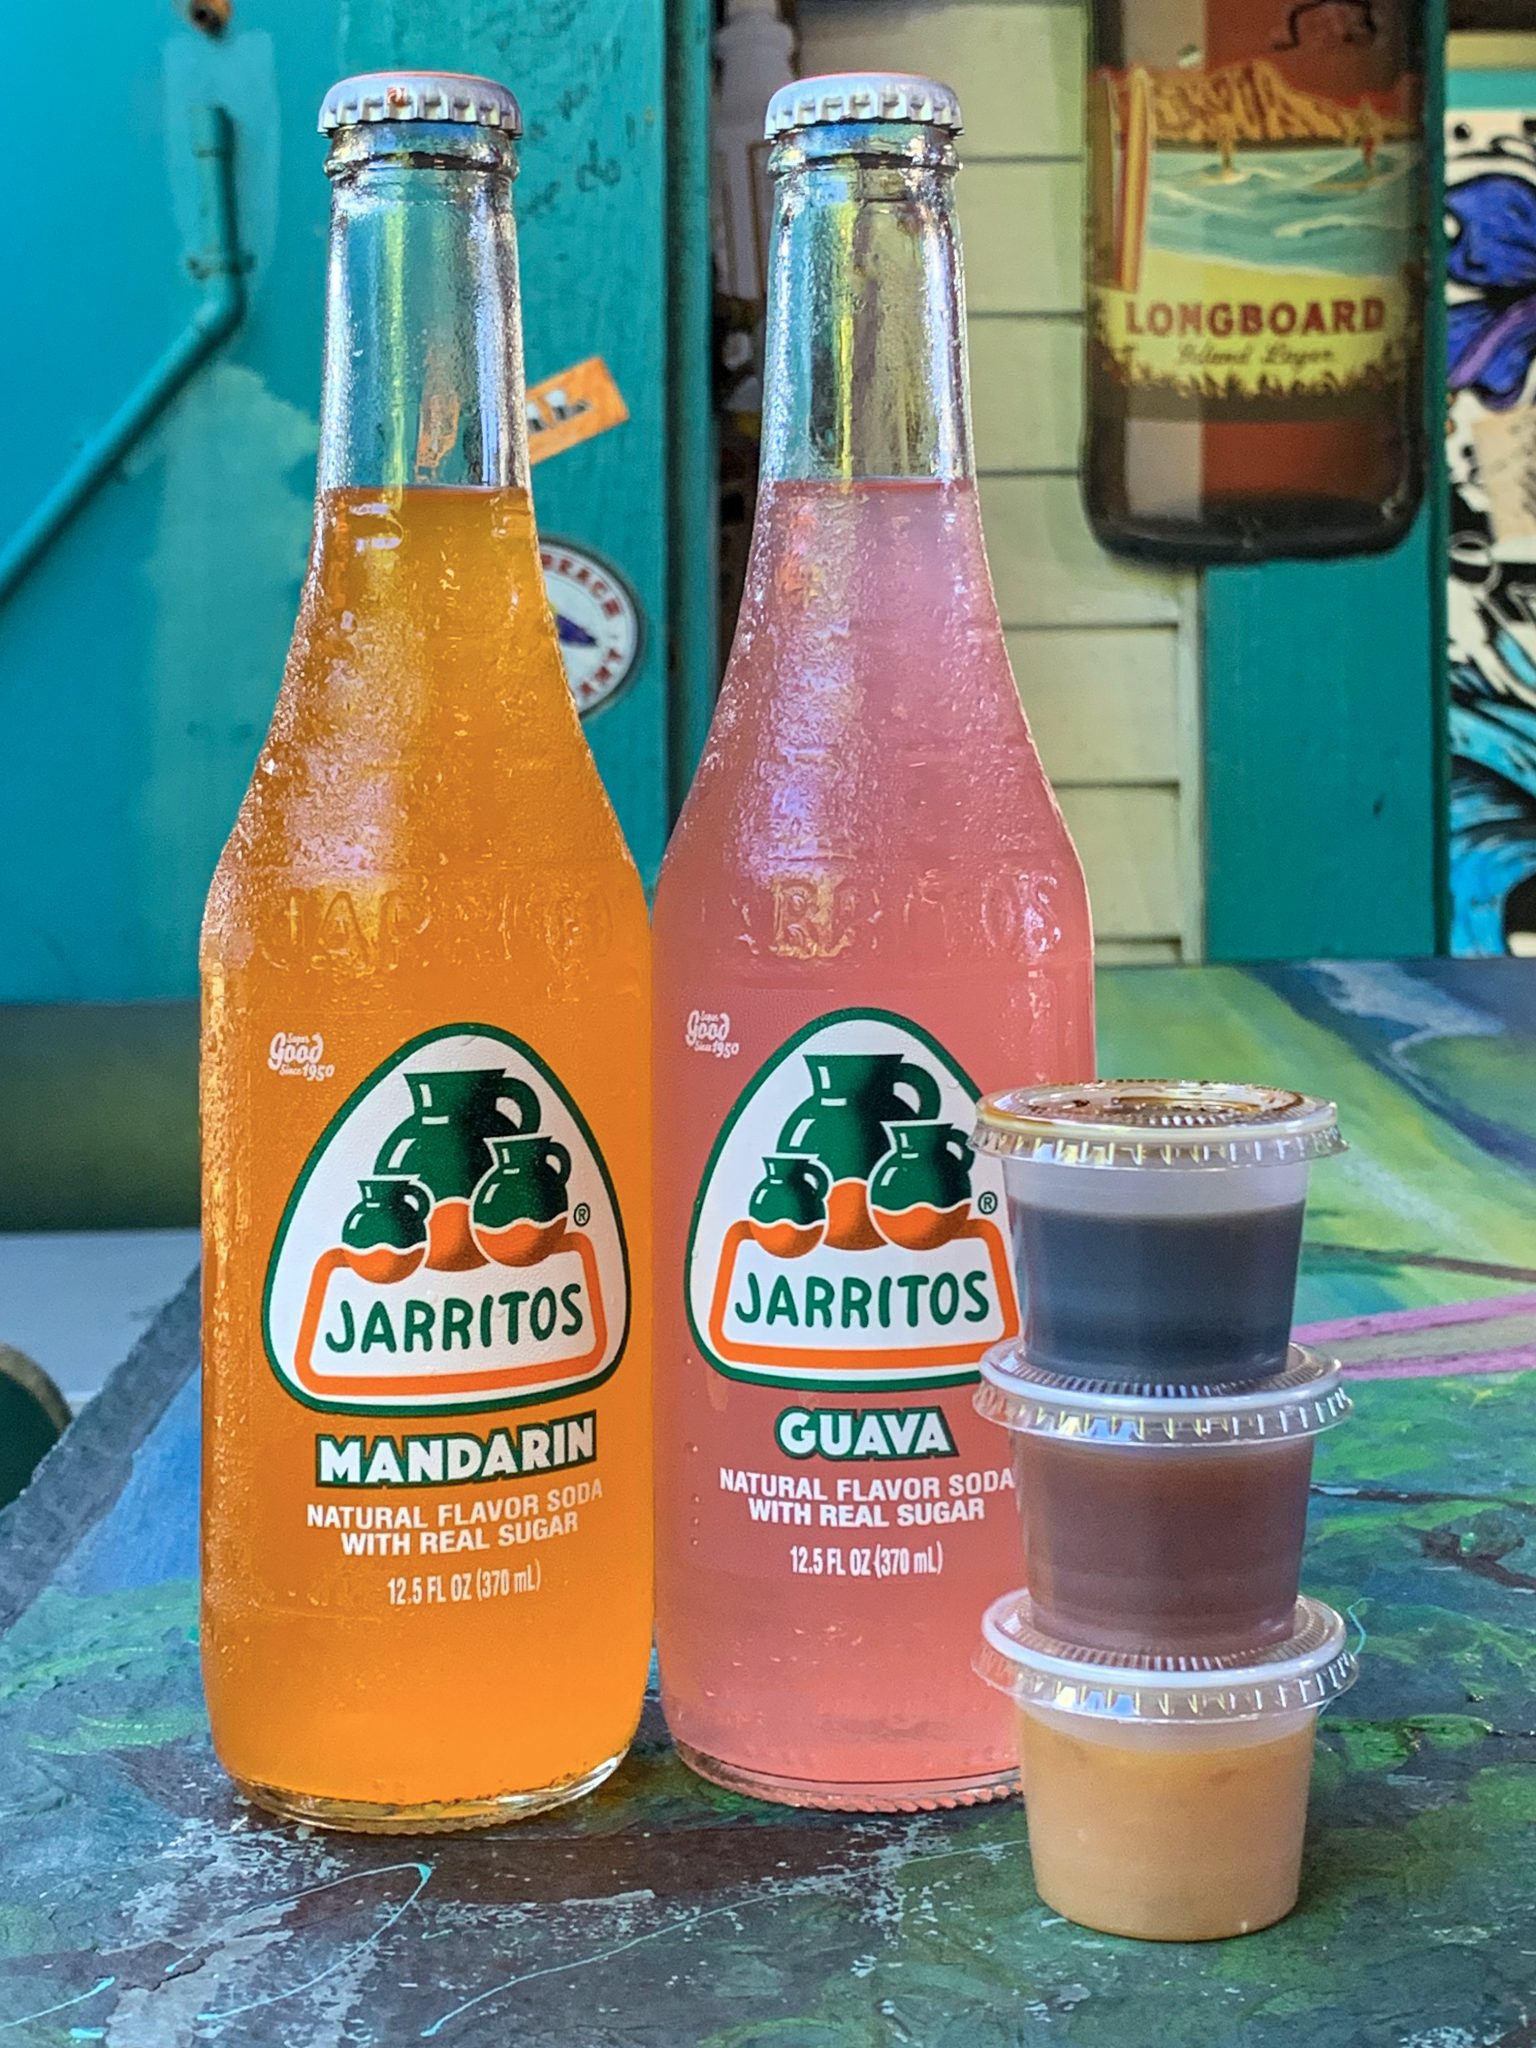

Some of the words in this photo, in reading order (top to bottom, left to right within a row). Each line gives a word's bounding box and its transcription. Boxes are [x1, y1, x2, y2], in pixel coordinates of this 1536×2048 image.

[1125, 297, 1386, 337] LONGBOARD
[302, 1063, 336, 1082] 1950
[325, 1282, 583, 1353] JARRITOS
[734, 1270, 990, 1329] JARRITOS
[317, 1411, 595, 1486] MANDARIN
[777, 1408, 956, 1459] GUAVA
[307, 1504, 428, 1529] NATURAL
[438, 1494, 539, 1528] FLAVOR
[546, 1478, 602, 1512] SODA
[719, 1467, 828, 1501] NATURAL
[837, 1477, 940, 1502] FLAVOR
[949, 1467, 1016, 1498] SODA
[341, 1533, 411, 1556] WITH
[420, 1528, 489, 1555] REAL
[498, 1511, 578, 1547] SUGAR
[748, 1498, 812, 1526] WITH
[820, 1504, 889, 1528] REAL
[897, 1498, 985, 1527] SUGAR
[387, 1577, 422, 1605] 12.5
[427, 1575, 446, 1602] FL
[451, 1572, 472, 1601] OZ
[476, 1567, 509, 1601] (370
[514, 1558, 542, 1593] mL)
[790, 1546, 824, 1575] 12.5
[827, 1548, 846, 1576] FL
[850, 1548, 871, 1576] OZ
[874, 1544, 909, 1579] (370
[914, 1541, 943, 1576] mL)
